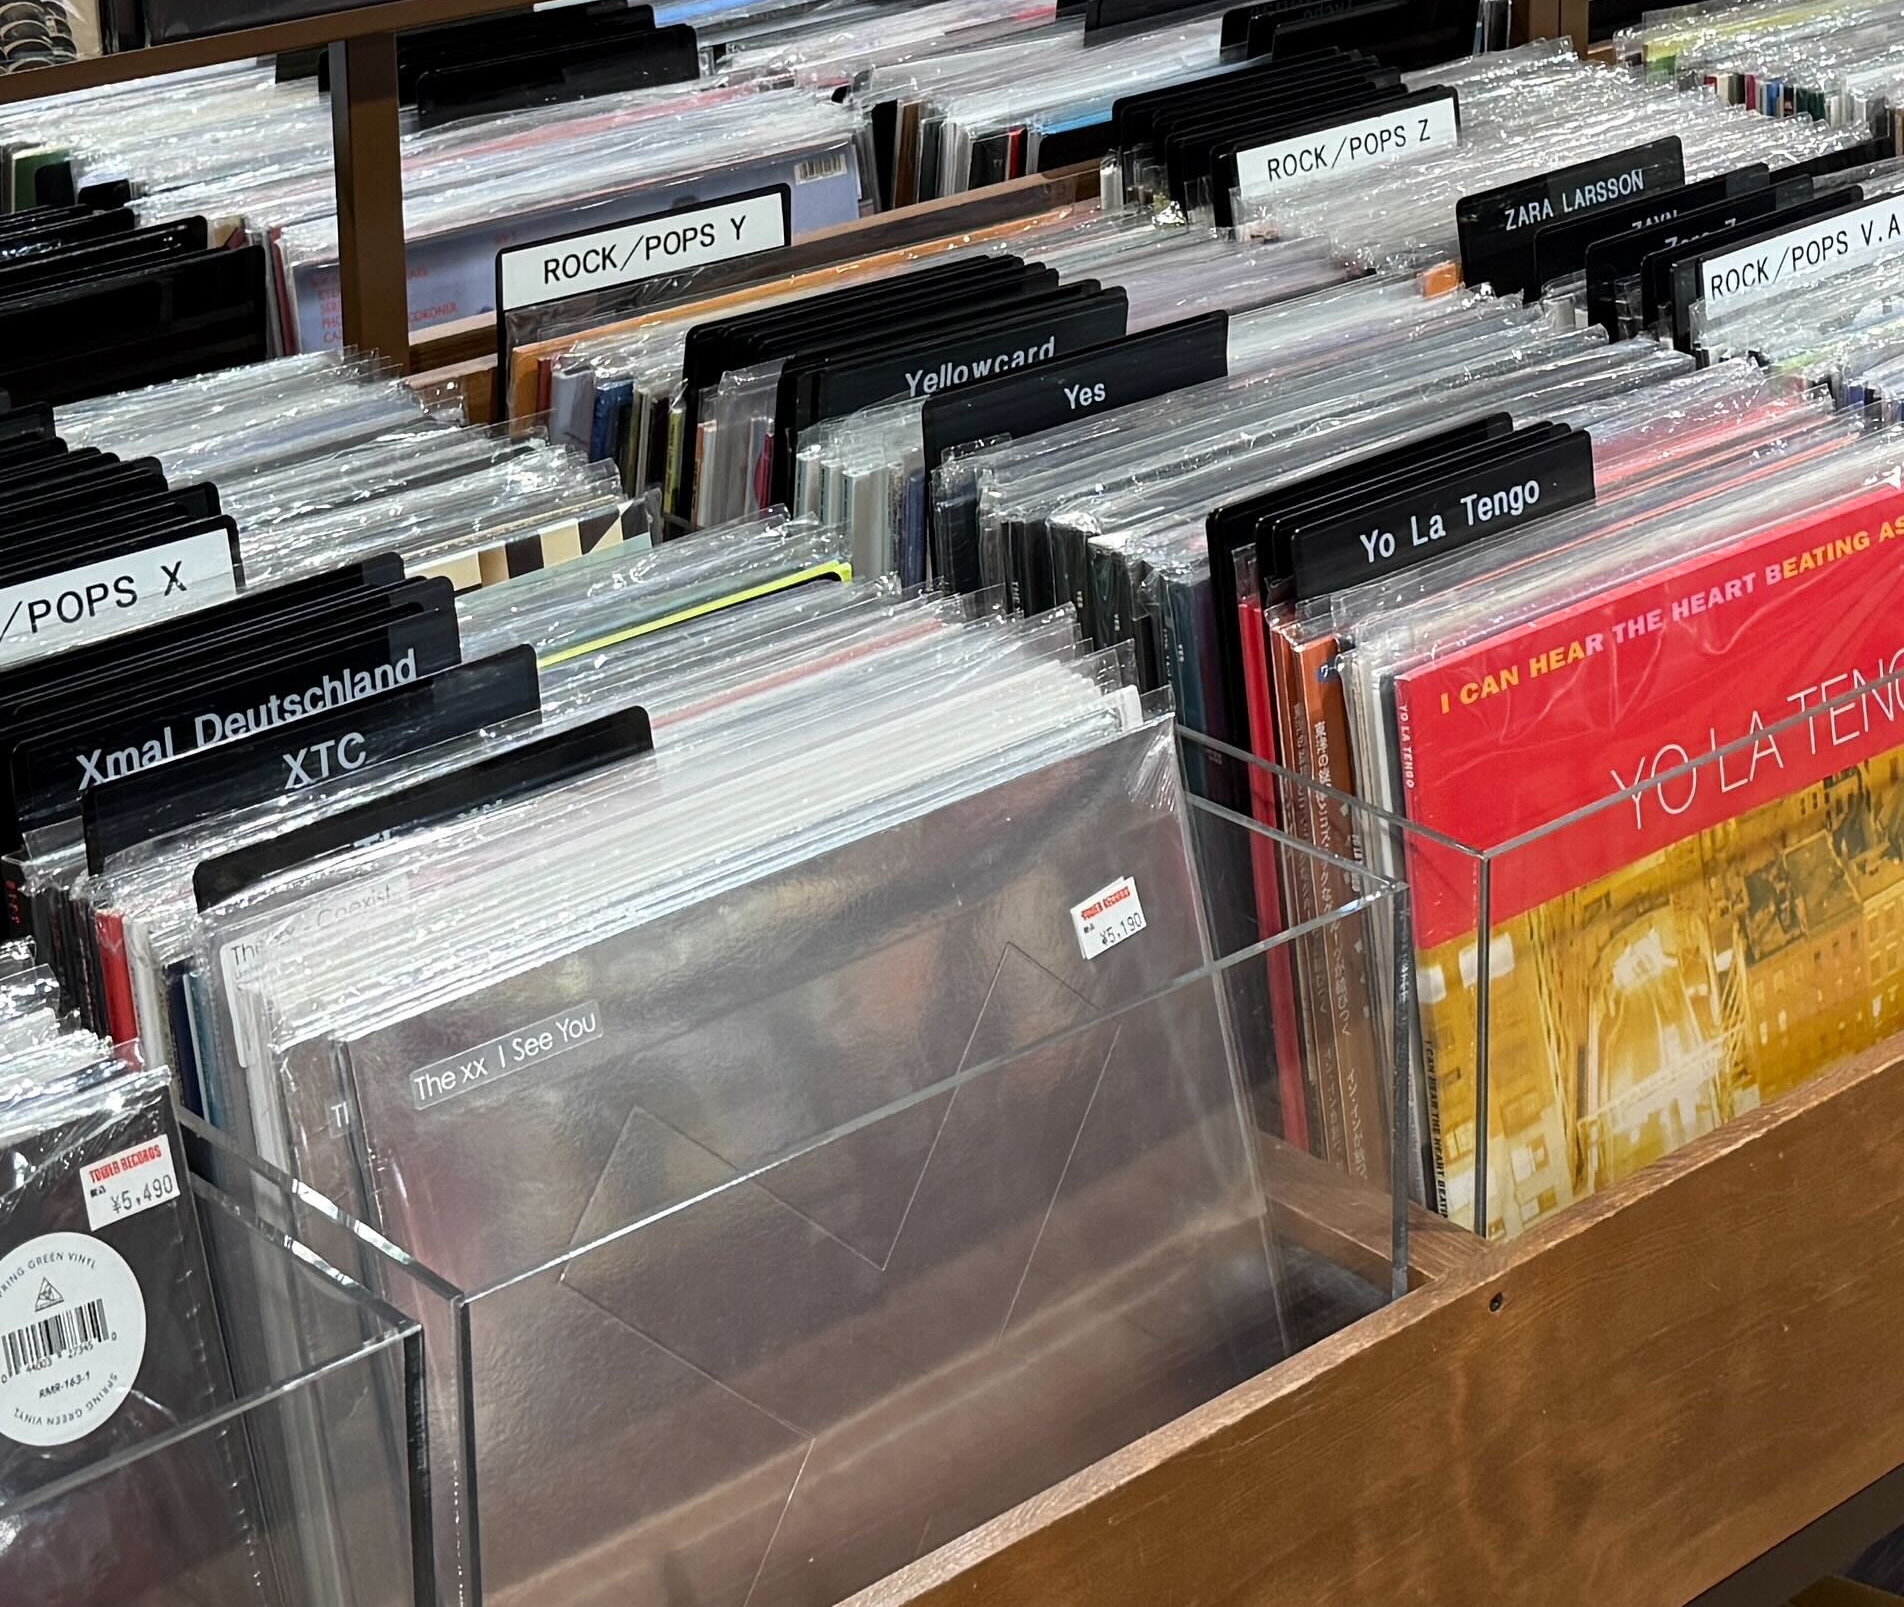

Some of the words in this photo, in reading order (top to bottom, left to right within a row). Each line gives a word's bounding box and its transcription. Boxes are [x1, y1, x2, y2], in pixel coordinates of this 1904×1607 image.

[1267, 125, 1407, 182] ROCK/POPS
[1418, 118, 1431, 142] Z
[1504, 198, 1555, 232] ZARA
[1562, 168, 1645, 214] LARSSON
[543, 223, 714, 285] ROCK/POPS
[729, 215, 747, 241] Y
[1710, 230, 1848, 300] ROCK/POPS
[904, 336, 1056, 398] Yellowcard
[1064, 381, 1106, 411] Yes
[1359, 528, 1396, 564] Yo
[1410, 514, 1445, 546] La
[1459, 479, 1541, 529] Tengo
[160, 561, 187, 598] X
[1440, 692, 1451, 716] I
[1459, 664, 1521, 706] CAN
[1529, 632, 1606, 675] HEAR
[1611, 610, 1663, 646] THE
[1671, 572, 1756, 622] HEART
[1764, 531, 1871, 585] BEATING
[75, 727, 175, 792] Xmal
[194, 647, 418, 746] Deutschland
[281, 732, 367, 789] XTC
[1610, 742, 1700, 832] YO
[1716, 708, 1784, 791] LA
[1099, 911, 1142, 946] ¥5,190
[413, 1075, 456, 1101] The
[459, 1058, 488, 1082] xx
[498, 1045, 506, 1069] I
[511, 1036, 553, 1061] See
[556, 1013, 598, 1042] You
[89, 1160, 121, 1183] TOWER
[120, 1144, 163, 1171] RECORDS
[111, 1174, 173, 1214] ¥5,490
[27, 1252, 64, 1273] GREEN
[66, 1251, 97, 1270] VINYL
